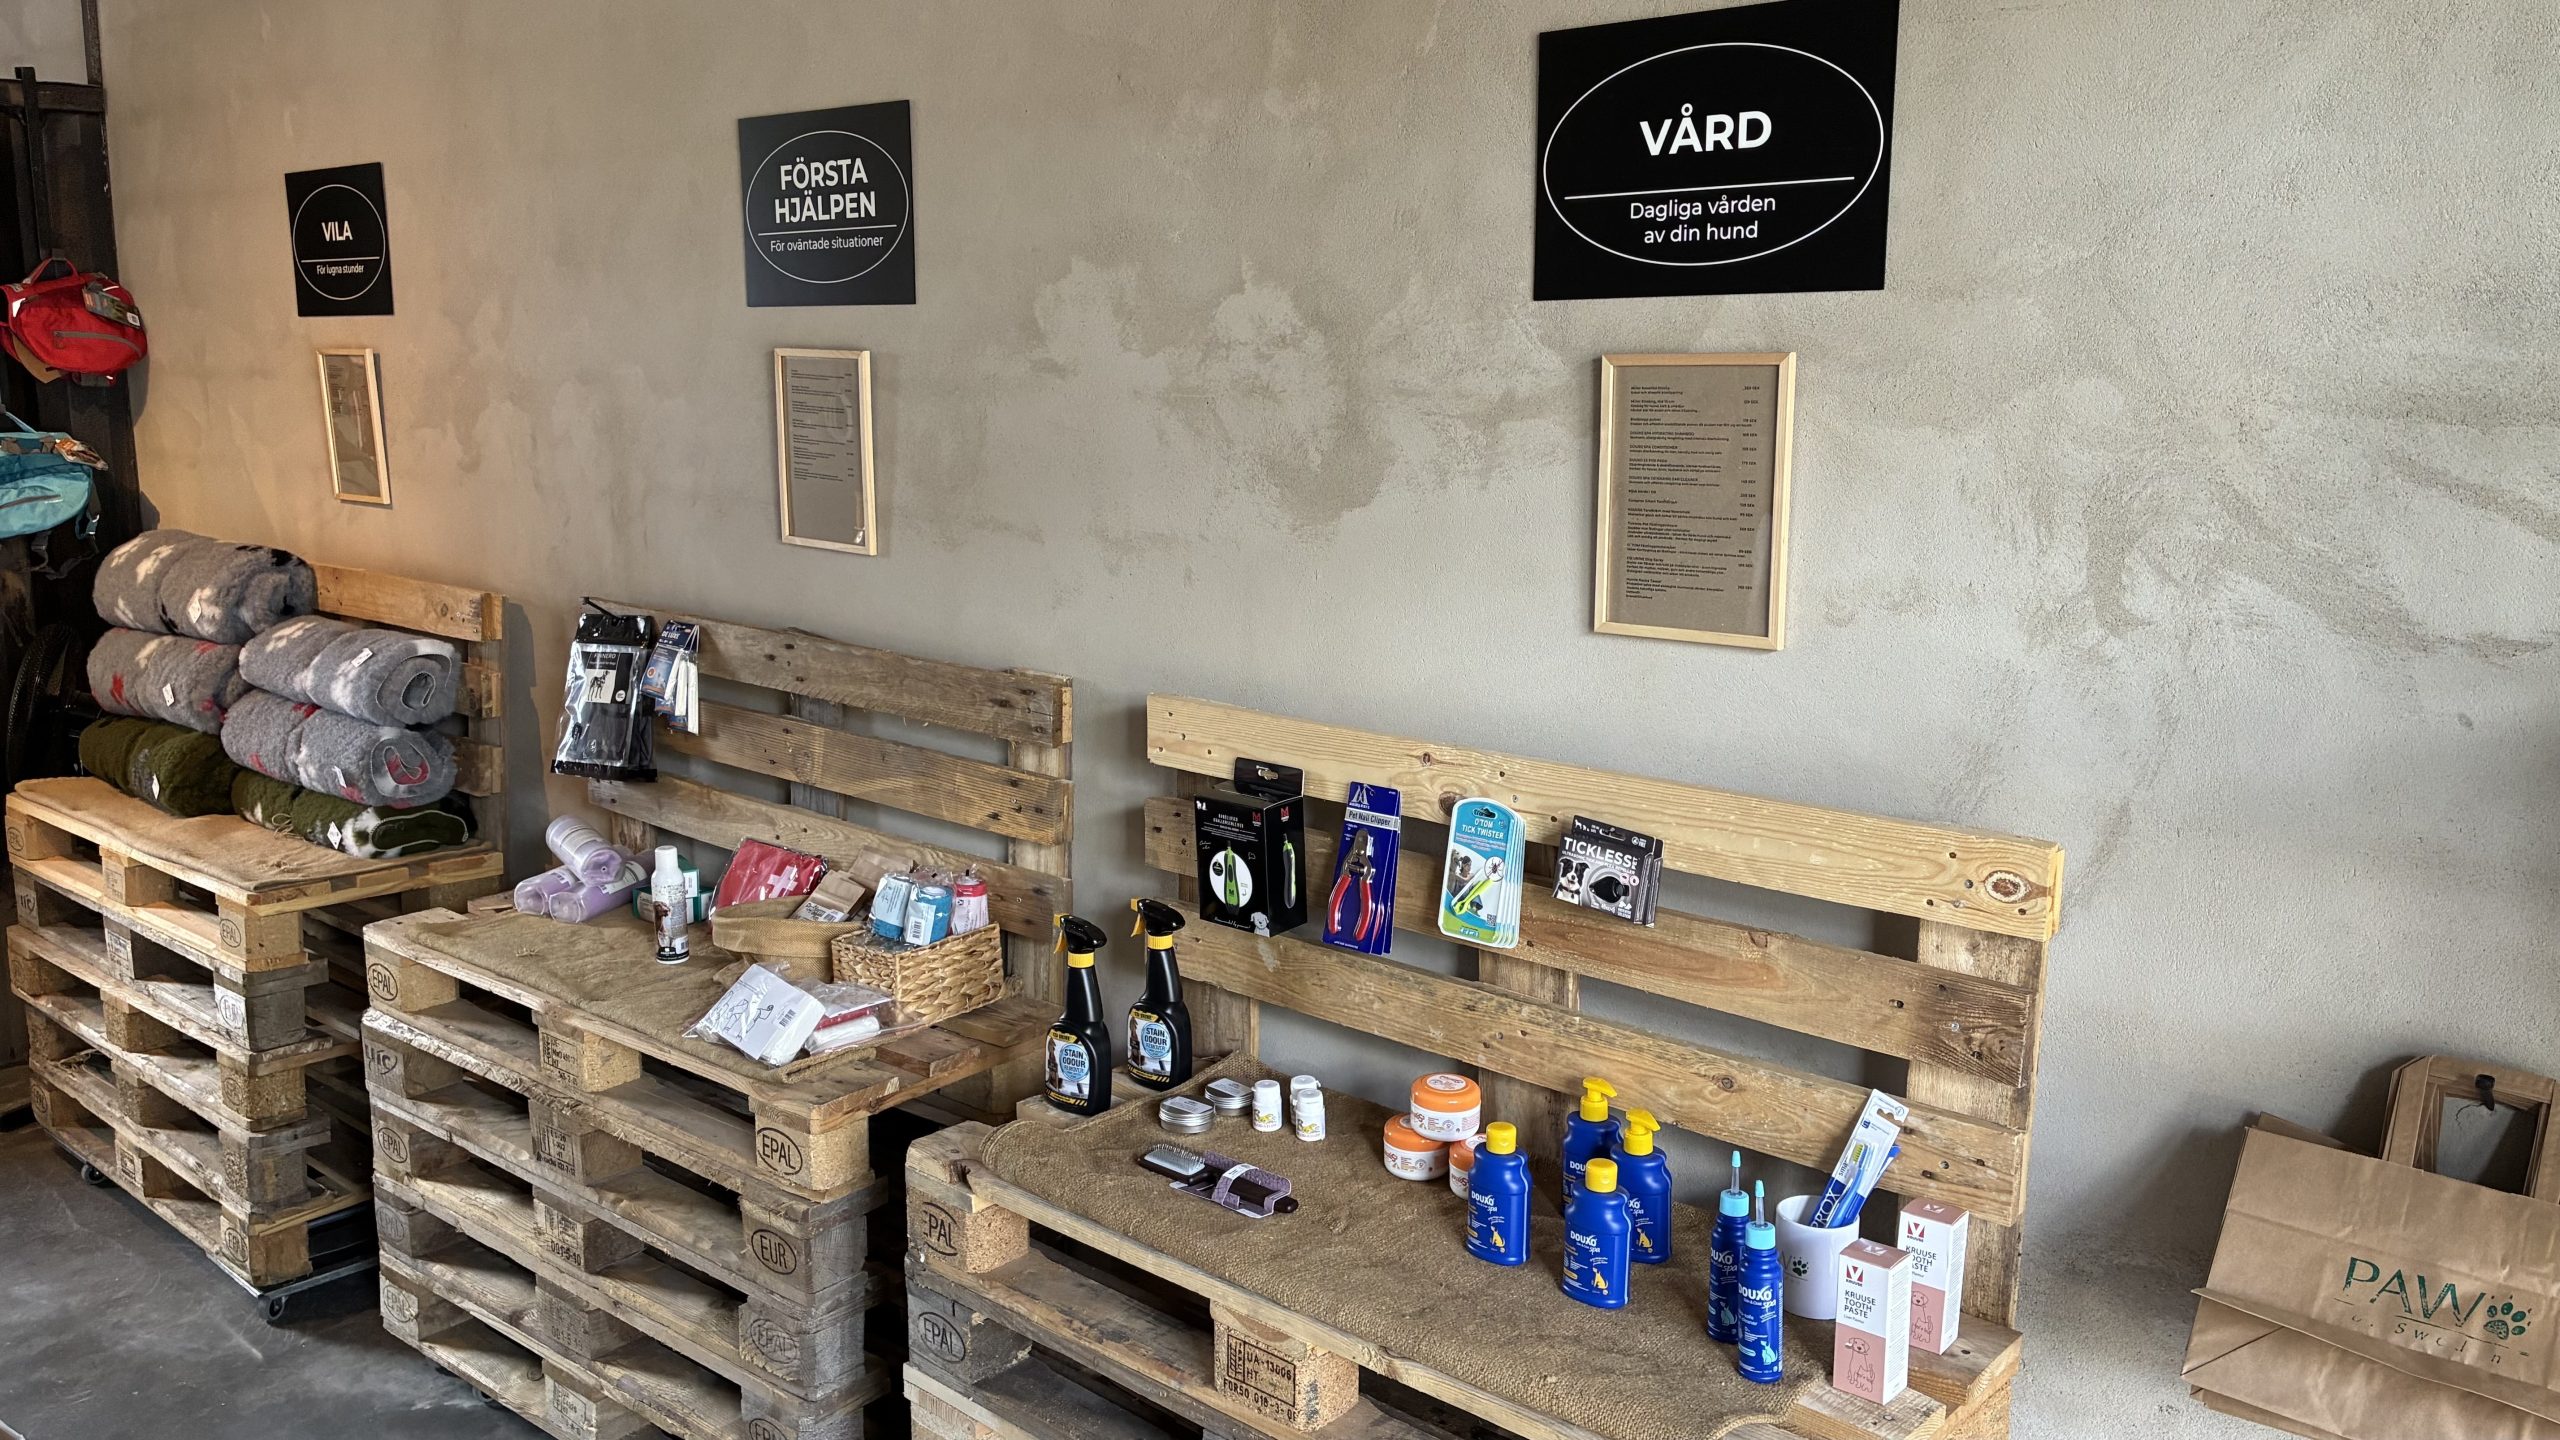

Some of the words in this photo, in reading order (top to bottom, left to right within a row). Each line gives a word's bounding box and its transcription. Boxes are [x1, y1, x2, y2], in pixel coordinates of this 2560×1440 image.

[1639, 103, 1772, 156] VÅRD
[780, 156, 868, 190] FÖRSTA
[774, 189, 876, 224] HJÄLPEN
[1630, 199, 1702, 221] Dagliga
[1707, 194, 1776, 216] vården
[321, 220, 353, 242] VILA
[1643, 228, 1666, 244] av
[1670, 223, 1700, 242] din
[1706, 221, 1759, 241] hund
[770, 240, 785, 252] För
[787, 237, 830, 251] oväntade
[831, 235, 884, 249] situationer
[342, 262, 364, 274] stunder
[1349, 811, 1358, 819] Pet
[1358, 812, 1370, 821] Nail
[1370, 815, 1391, 826] Clipper
[1462, 824, 1476, 834] TICK
[1477, 827, 1504, 840] TWISTER
[1563, 836, 1632, 869] TICKLESS
[372, 968, 394, 997] EPAL
[1144, 1034, 1167, 1046] ODOUR
[1146, 1027, 1165, 1038] STAIN
[1062, 1056, 1086, 1068] ODOUR
[1064, 1048, 1084, 1059] STAIN
[382, 1131, 404, 1160] EPAL
[762, 1133, 796, 1170] EPAL
[1569, 1160, 1586, 1172] DOU
[1471, 1190, 1495, 1206] DOUXO
[1570, 1230, 1598, 1247] DOUXO
[759, 1234, 788, 1270] EUR
[1711, 1247, 1734, 1265] UXO
[1905, 1245, 1937, 1260] KRUUSE
[1912, 1254, 1933, 1267] OTH
[1912, 1262, 1929, 1273] STE
[1738, 1282, 1773, 1301] DOUXO
[1844, 1289, 1876, 1306] KRUUSE
[2342, 1256, 2487, 1328] PAW
[1762, 1299, 1777, 1313] spa
[1844, 1297, 1872, 1312] TOOTH
[1844, 1305, 1869, 1319] PASTE
[923, 1317, 961, 1361] EPAL
[1246, 1367, 1259, 1380] HT
